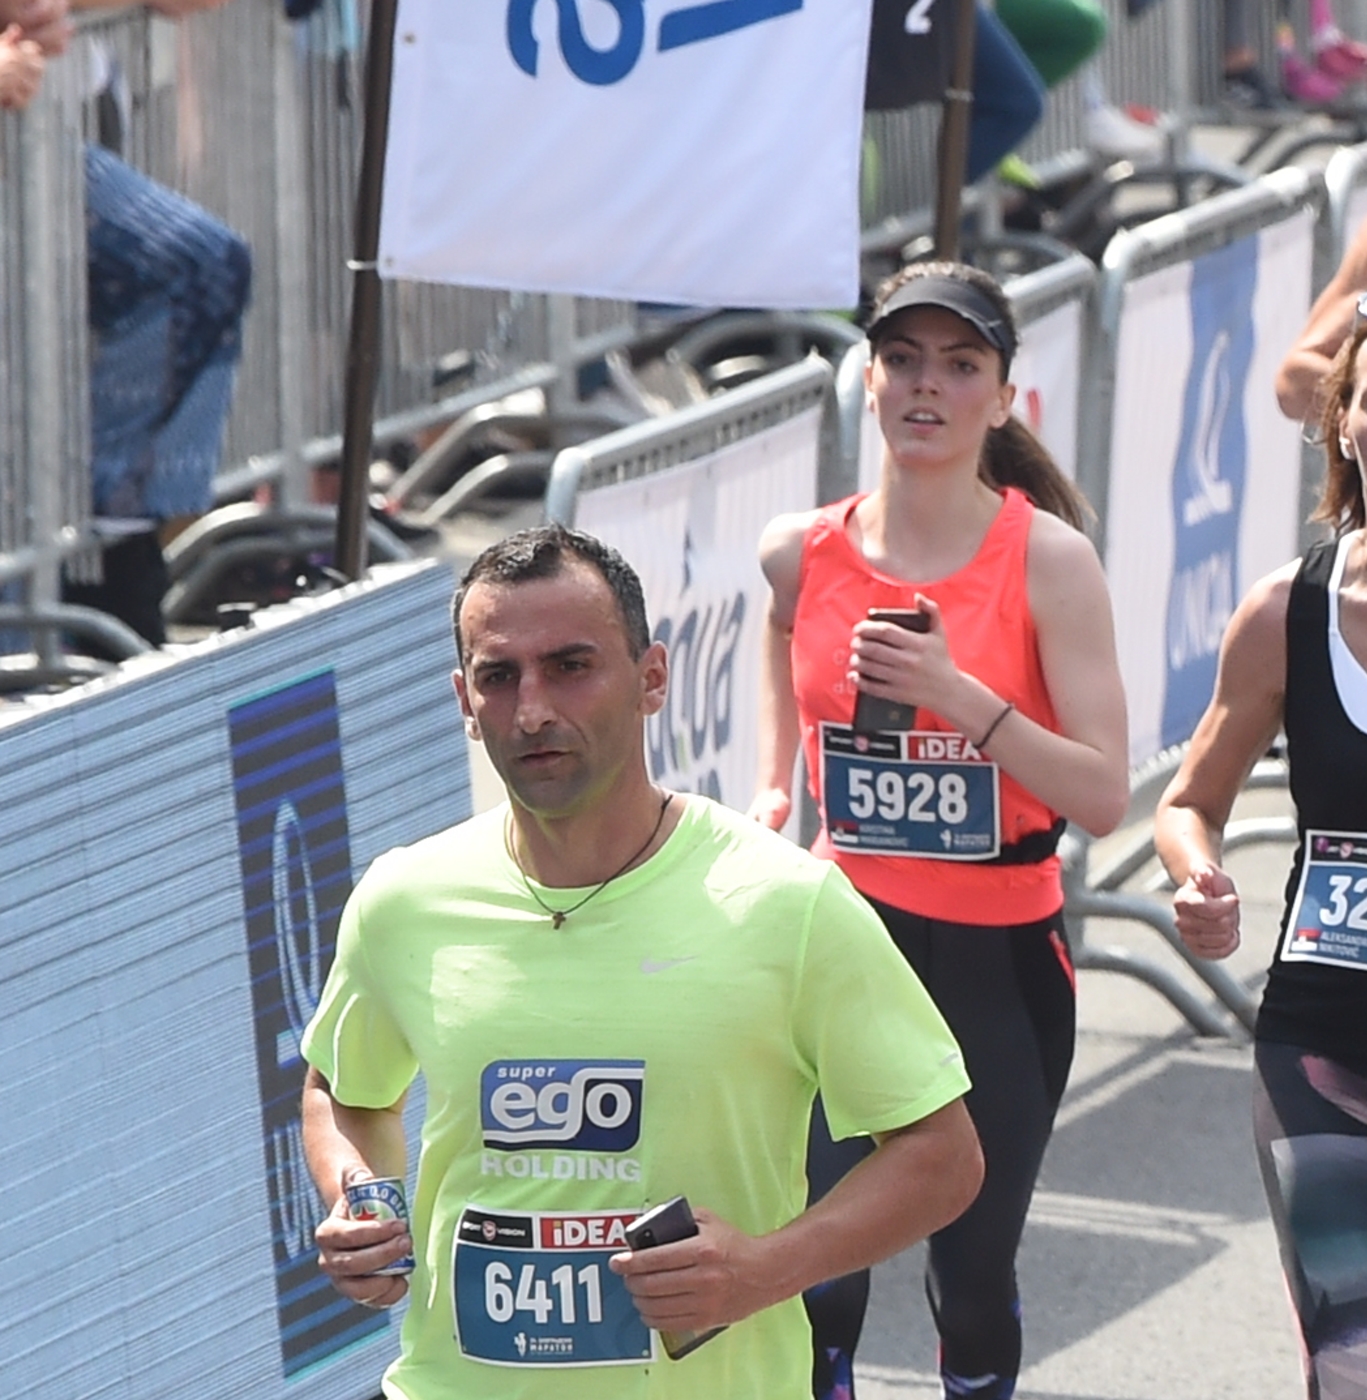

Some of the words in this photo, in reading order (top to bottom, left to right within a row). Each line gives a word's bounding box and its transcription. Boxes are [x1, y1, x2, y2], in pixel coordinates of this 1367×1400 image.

[919, 739, 982, 760] iDEA
[848, 767, 969, 825] 5928
[497, 1066, 556, 1081] super
[490, 1080, 633, 1141] ego
[480, 1154, 642, 1182] HOLDING
[553, 1219, 628, 1247] iDEA
[484, 1261, 603, 1324] 6411
